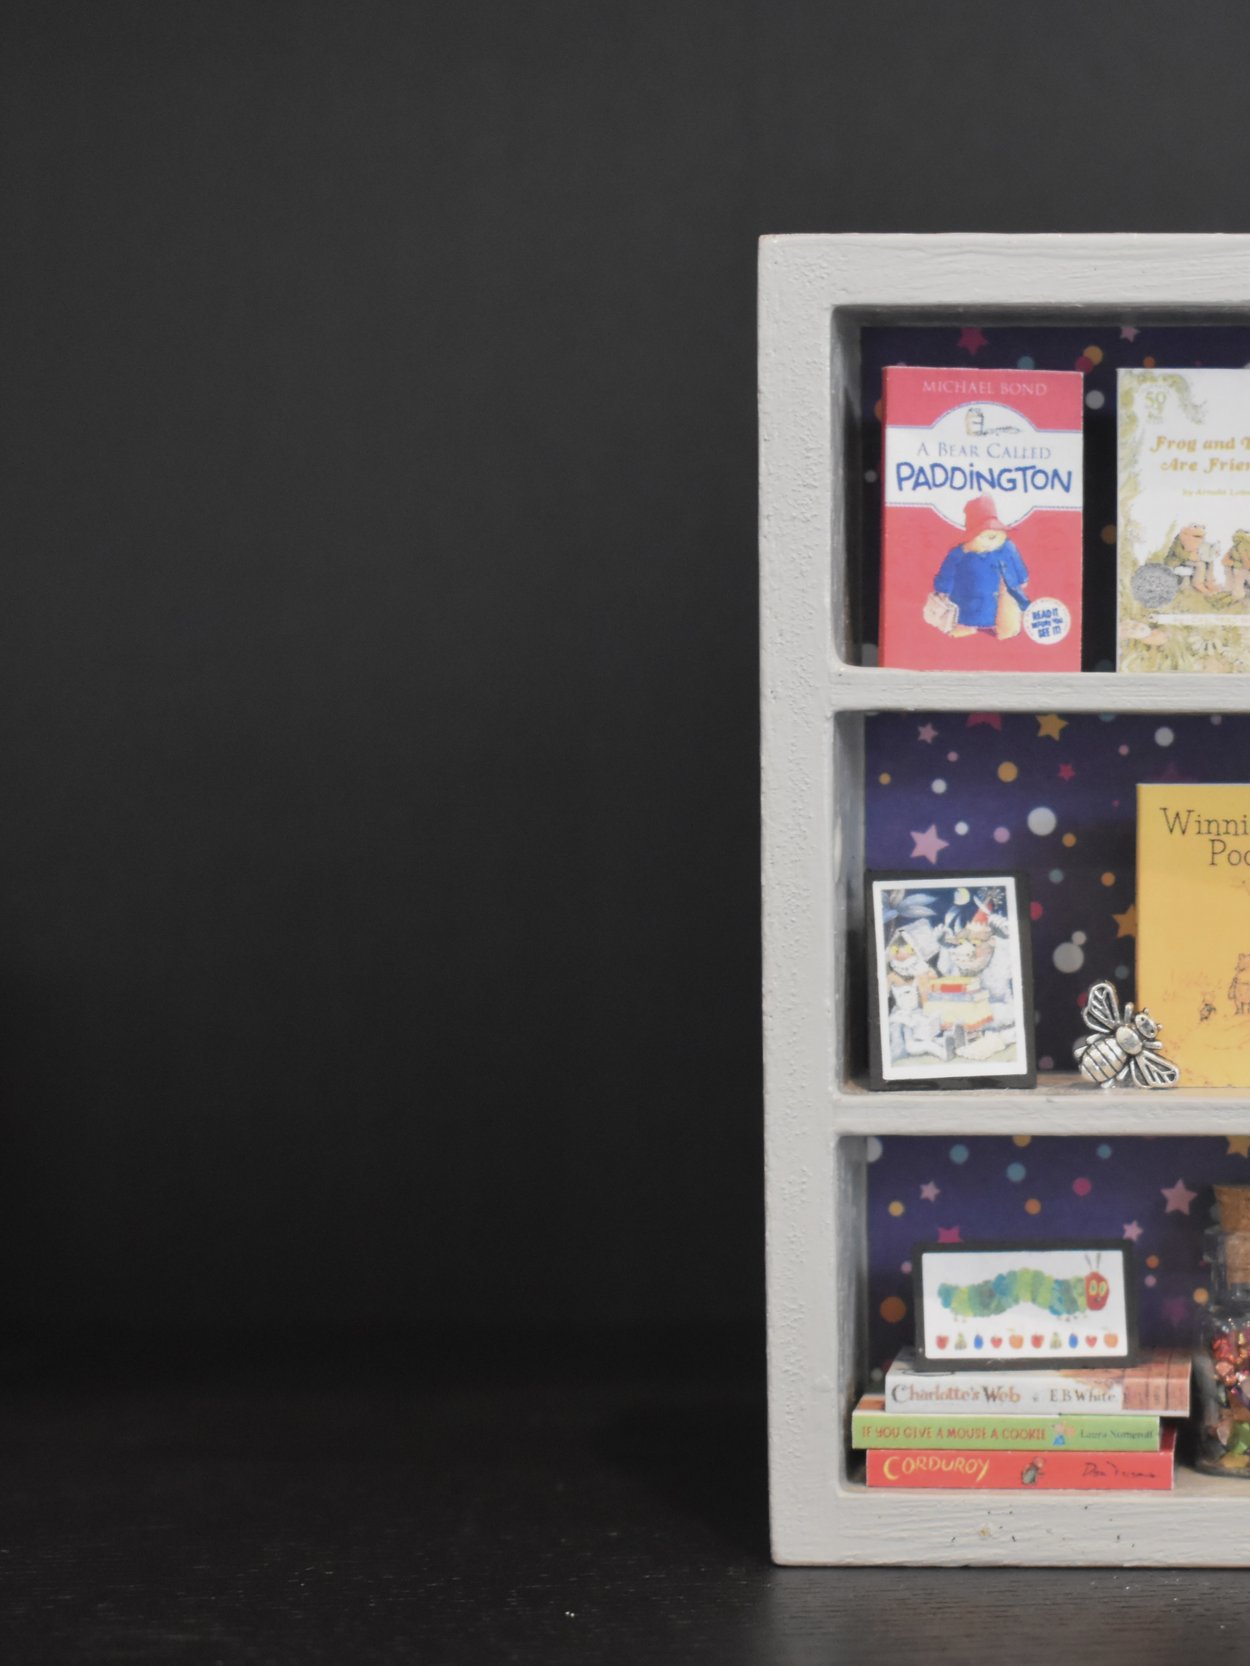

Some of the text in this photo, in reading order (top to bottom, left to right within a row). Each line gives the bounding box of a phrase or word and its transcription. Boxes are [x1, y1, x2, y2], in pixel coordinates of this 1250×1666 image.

[922, 380, 1048, 397] MICHAEL BOND
[917, 442, 1052, 460] A BEAR CALLED
[1151, 435, 1197, 453] Frog
[1203, 437, 1236, 450] and
[1160, 458, 1198, 472] Are
[892, 1384, 1021, 1403] Charlotte's Web
[875, 1426, 899, 1439] YOU
[903, 1426, 932, 1439] GIVE
[947, 1427, 986, 1440] MOUSE
[991, 1427, 999, 1440] A
[1002, 1427, 1046, 1441] COOKIE
[883, 1456, 990, 1482] CORDUROY
